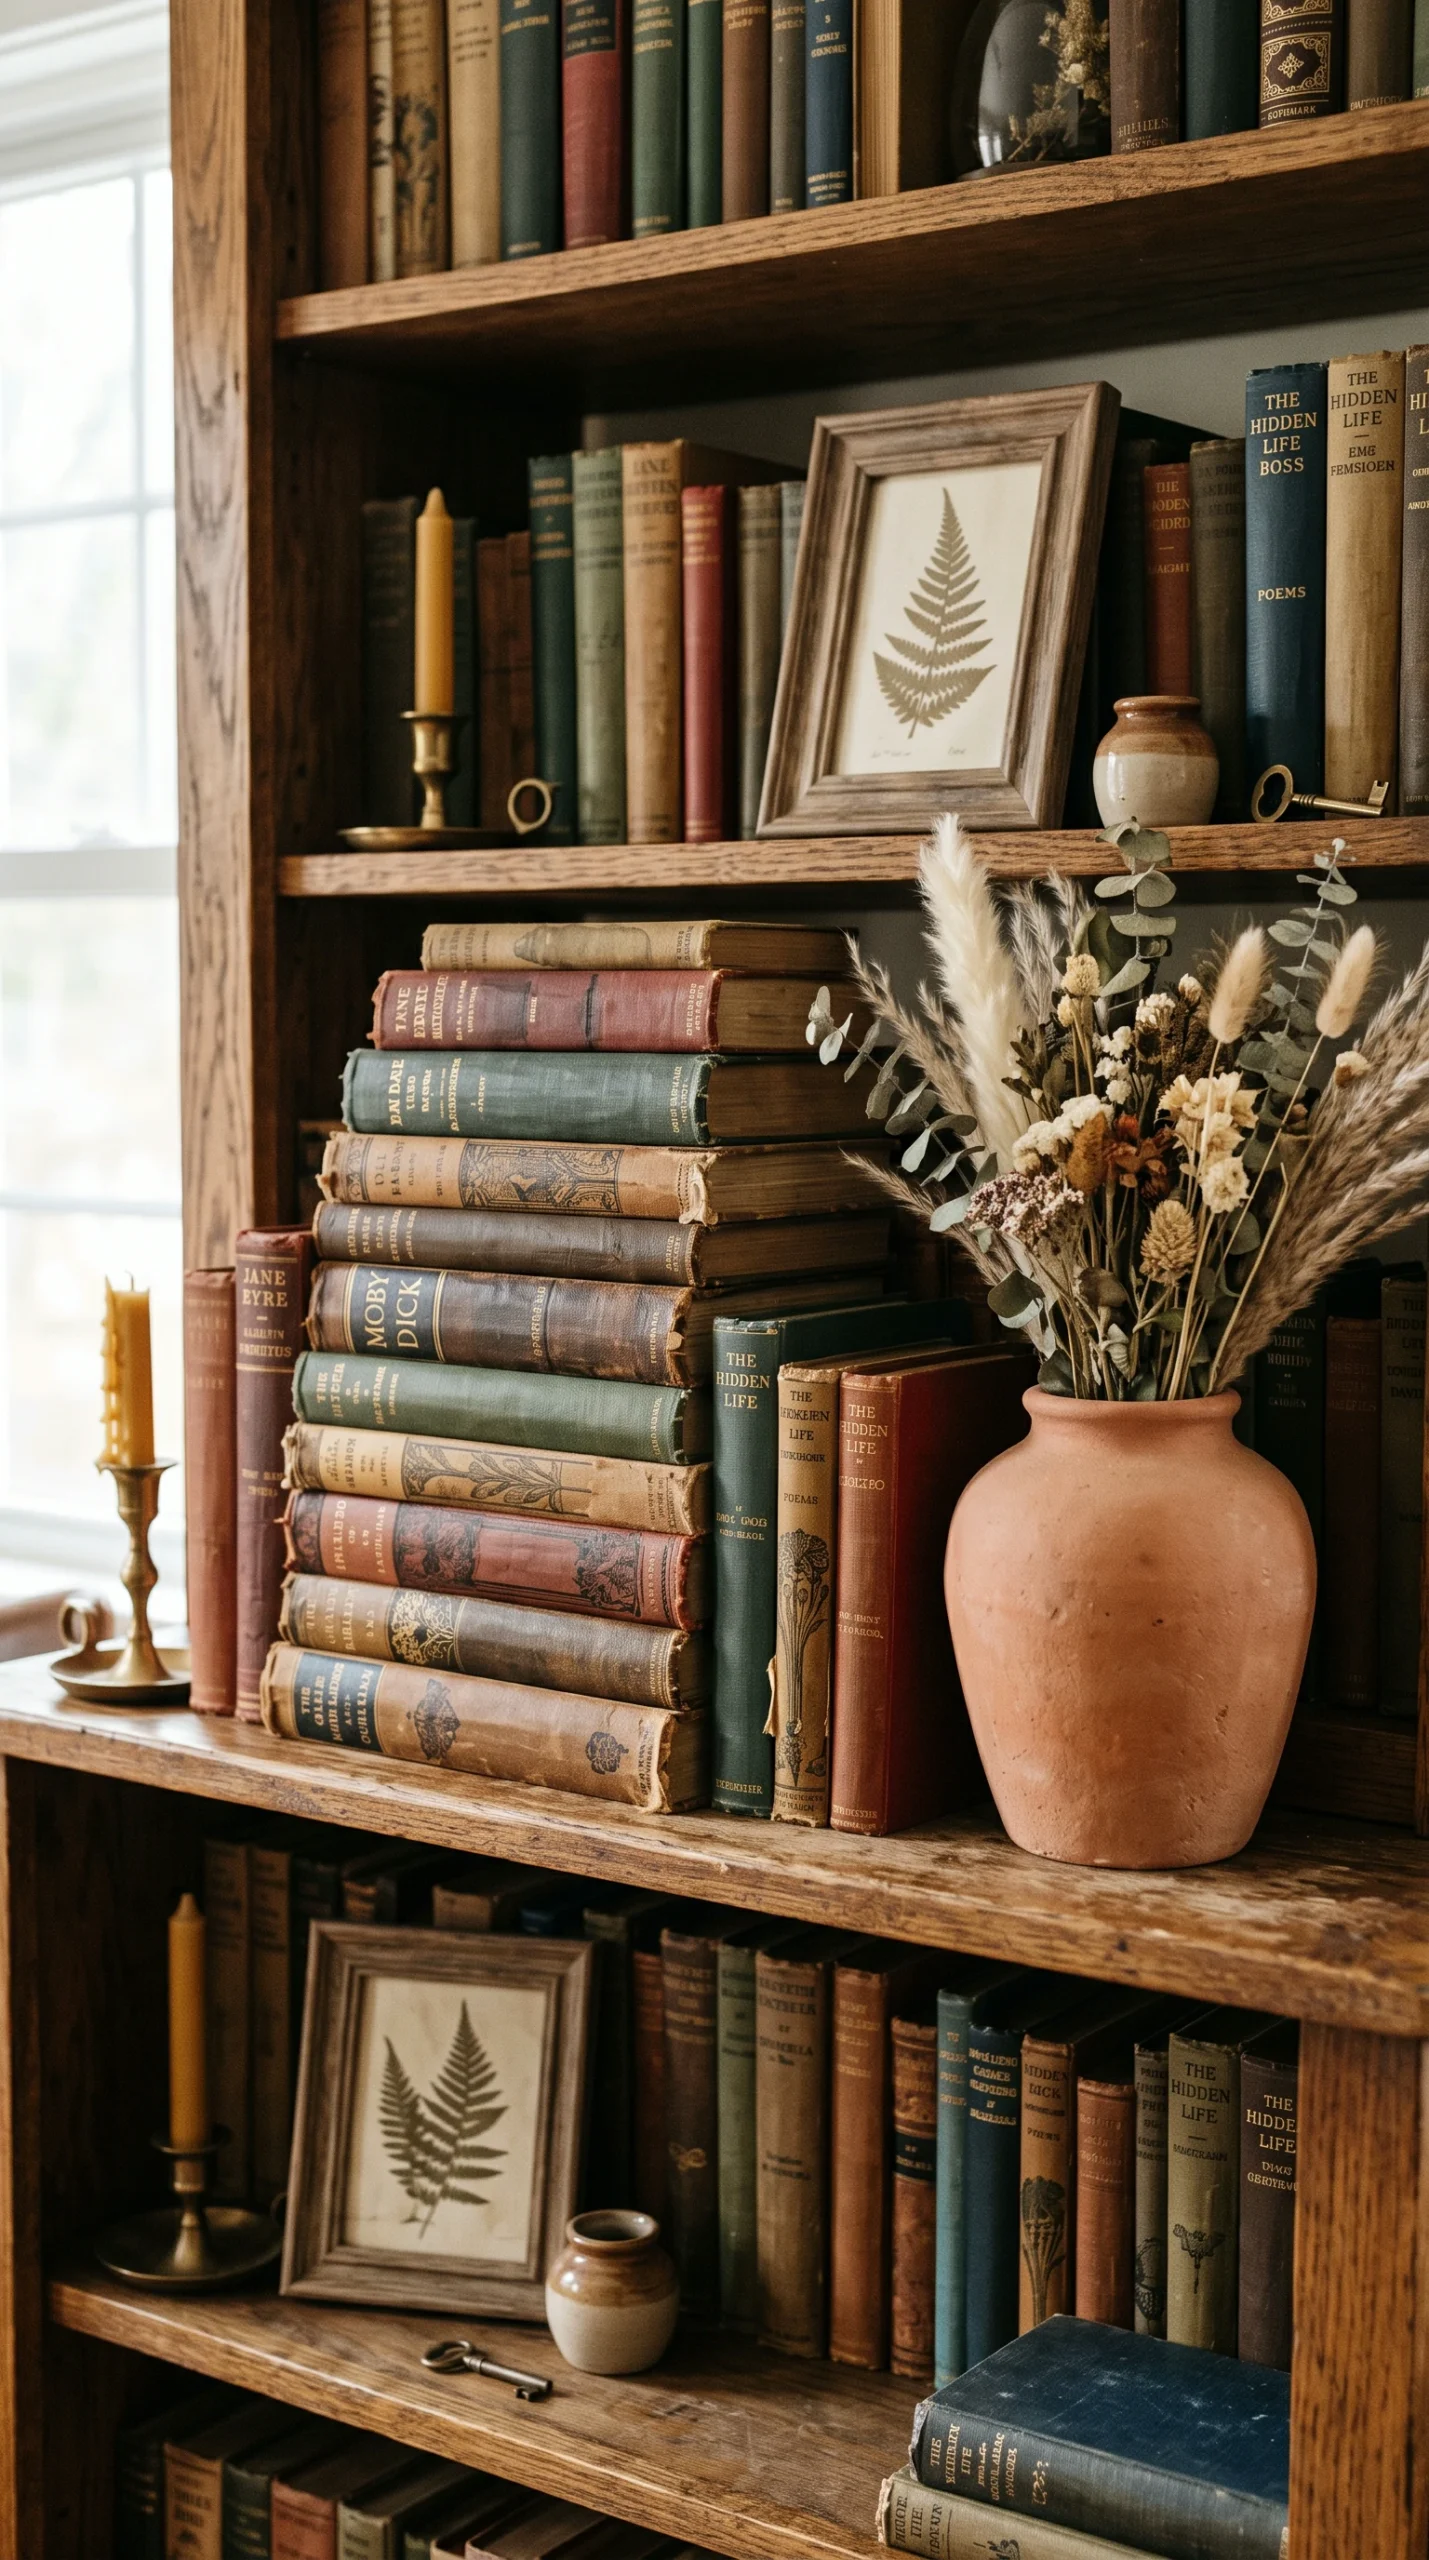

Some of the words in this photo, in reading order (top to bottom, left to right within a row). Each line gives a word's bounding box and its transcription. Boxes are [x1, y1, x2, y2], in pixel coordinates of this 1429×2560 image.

[1347, 371, 1378, 386] THE
[1265, 392, 1300, 411] THE
[1330, 388, 1398, 410] HIDDEN
[1250, 412, 1317, 435] HIDDEN
[1343, 410, 1382, 428] LIFE
[1263, 435, 1301, 455] LIFE
[1260, 457, 1304, 476] BOSS
[1257, 586, 1306, 601] POEMS
[243, 1267, 286, 1286] JANE
[242, 1289, 288, 1308] EYRE
[363, 1270, 390, 1349] MOBY
[396, 1277, 423, 1349] DICK
[726, 1352, 757, 1368] THE
[724, 1393, 758, 1409] LIFE
[790, 1390, 813, 1403] THE
[849, 1403, 876, 1419] THE
[789, 1428, 814, 1441] LIFE
[846, 1440, 876, 1455] LIFE
[784, 1493, 818, 1505] POEMS
[1185, 2062, 1217, 2082] THE
[1171, 2078, 1231, 2105] HIDDEN
[1264, 2094, 1293, 2112] THE
[1181, 2104, 1218, 2125] LIFE
[1246, 2108, 1298, 2133] HIDDE
[1259, 2133, 1297, 2154] LIFE
